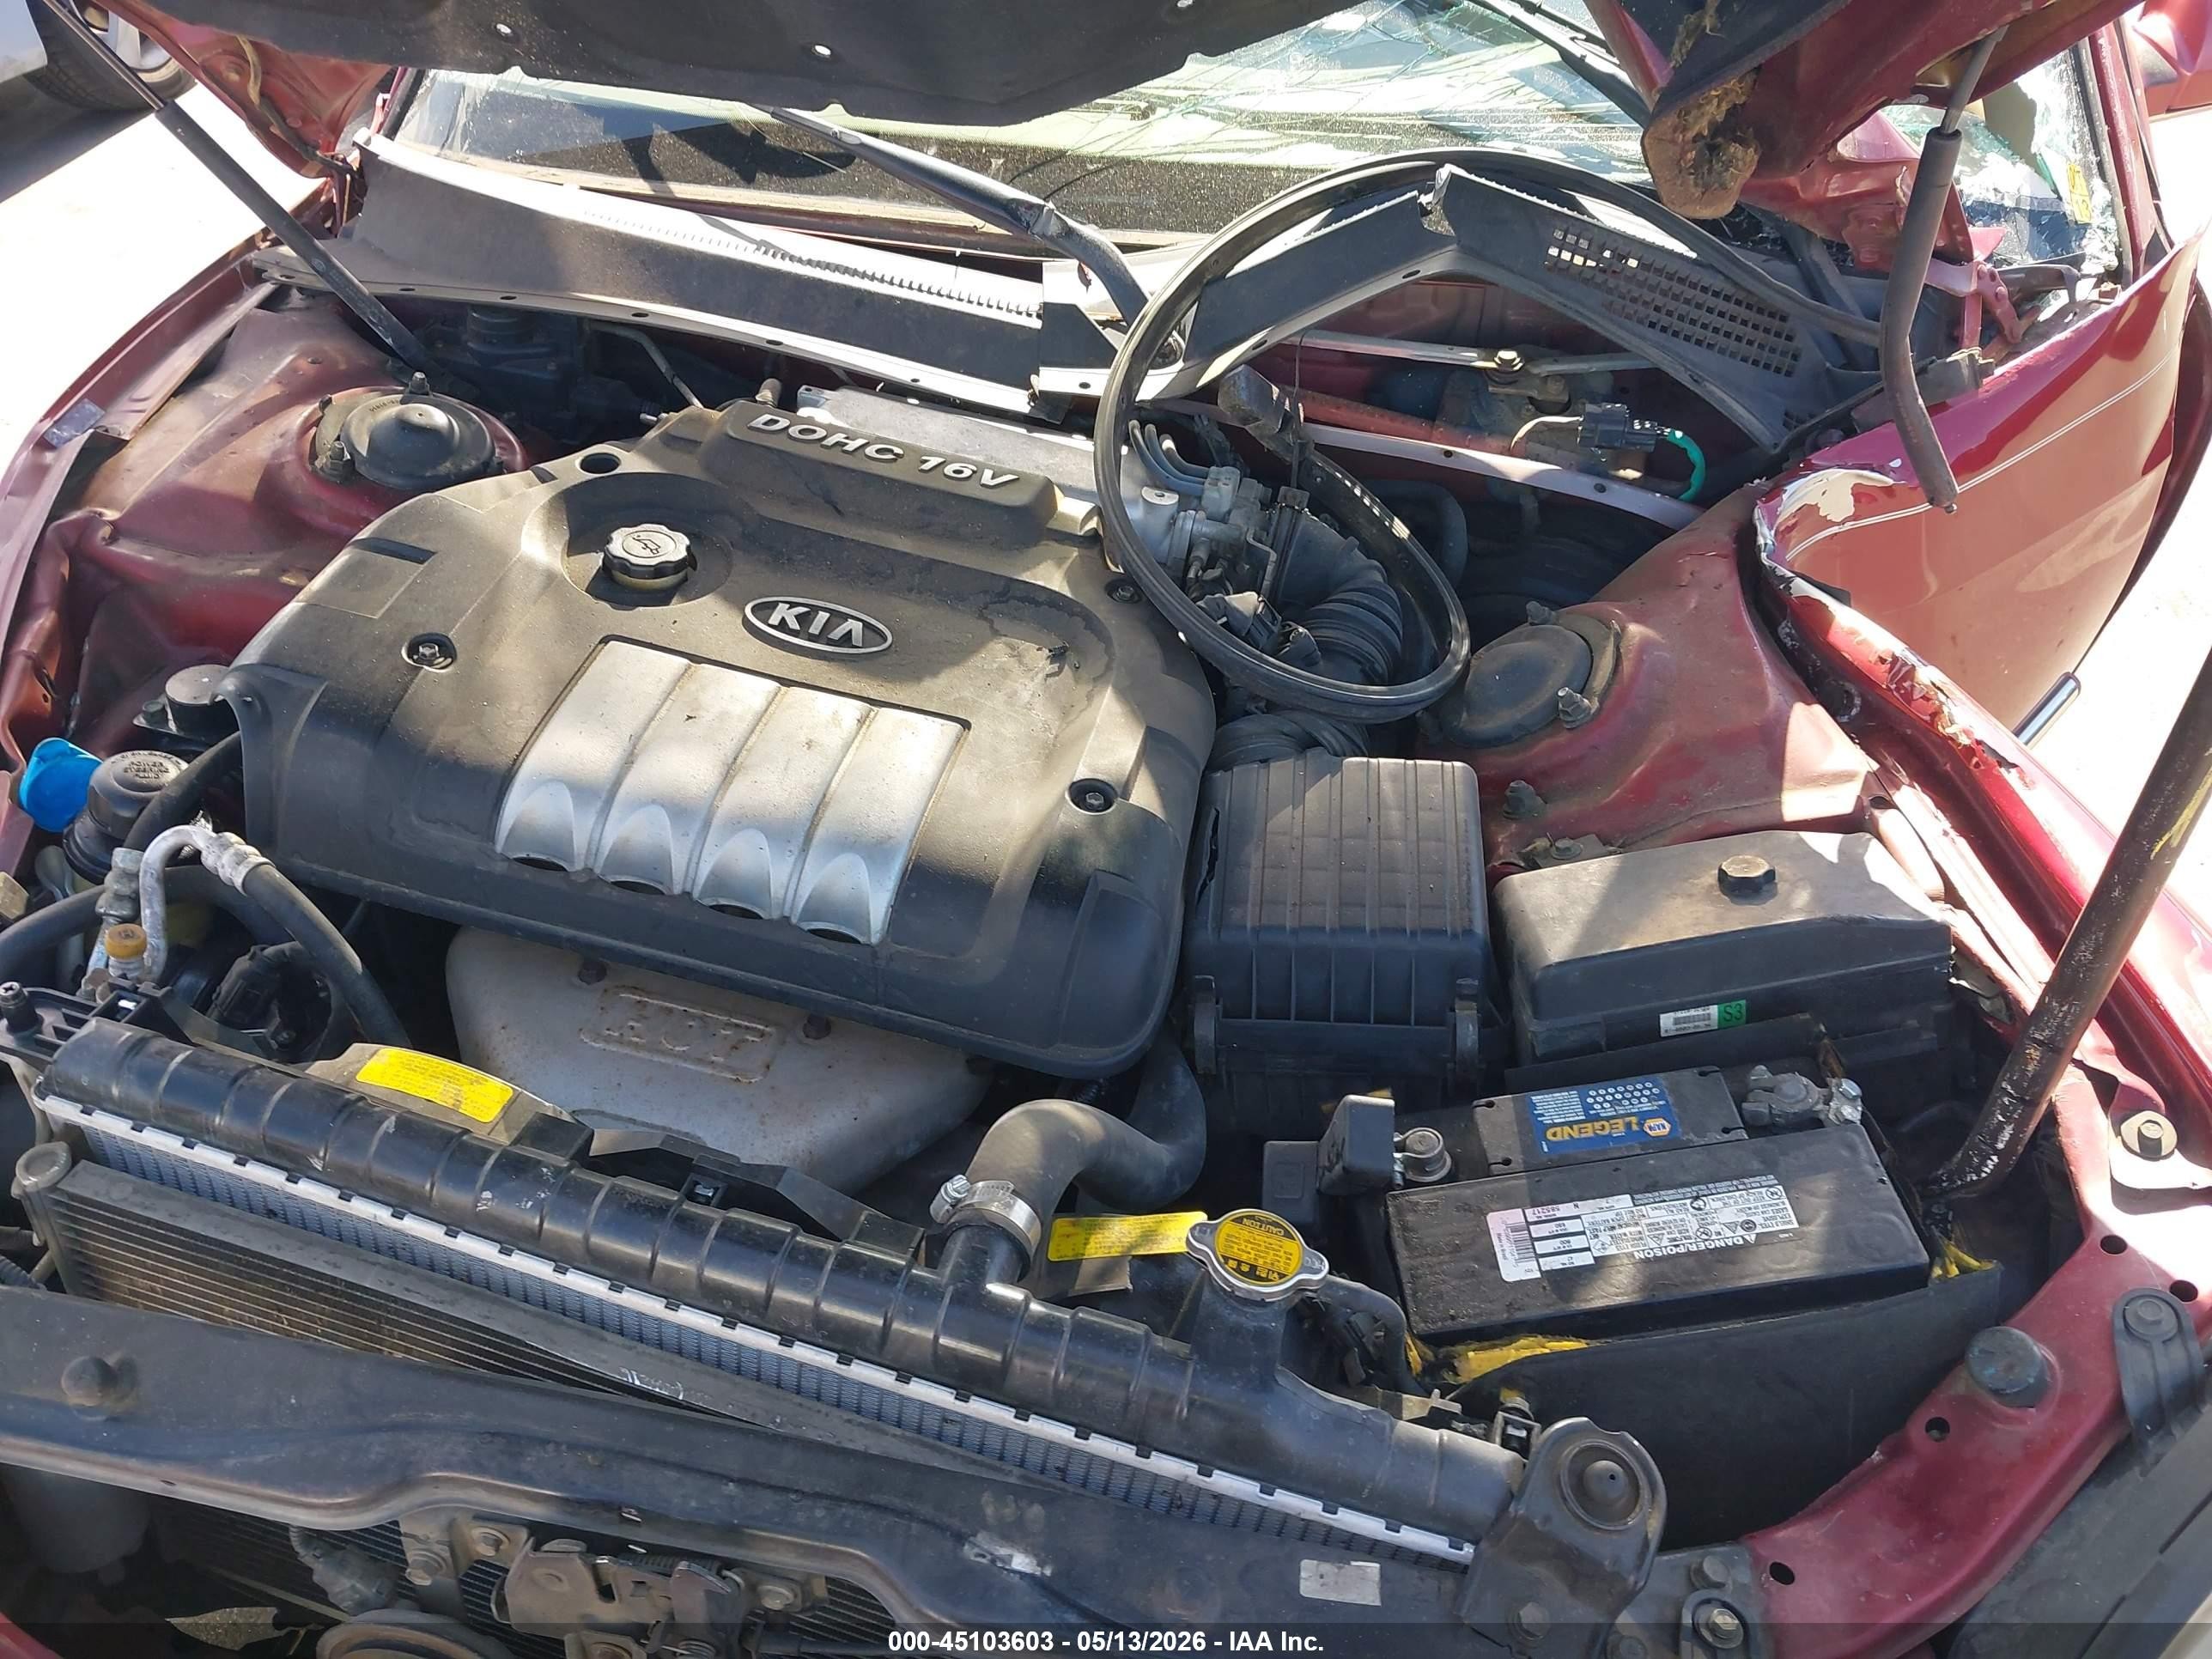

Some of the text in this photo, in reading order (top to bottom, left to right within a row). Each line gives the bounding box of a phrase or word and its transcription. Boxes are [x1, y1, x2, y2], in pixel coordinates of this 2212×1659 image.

[747, 414, 1019, 489] DOHC 16V
[768, 603, 864, 647] KIA
[1723, 1002, 1743, 1022] S3
[1546, 1115, 1641, 1142] LEGEND
[1243, 1218, 1285, 1237] CAUTION
[1634, 1234, 1747, 1260] DANGER/POISON
